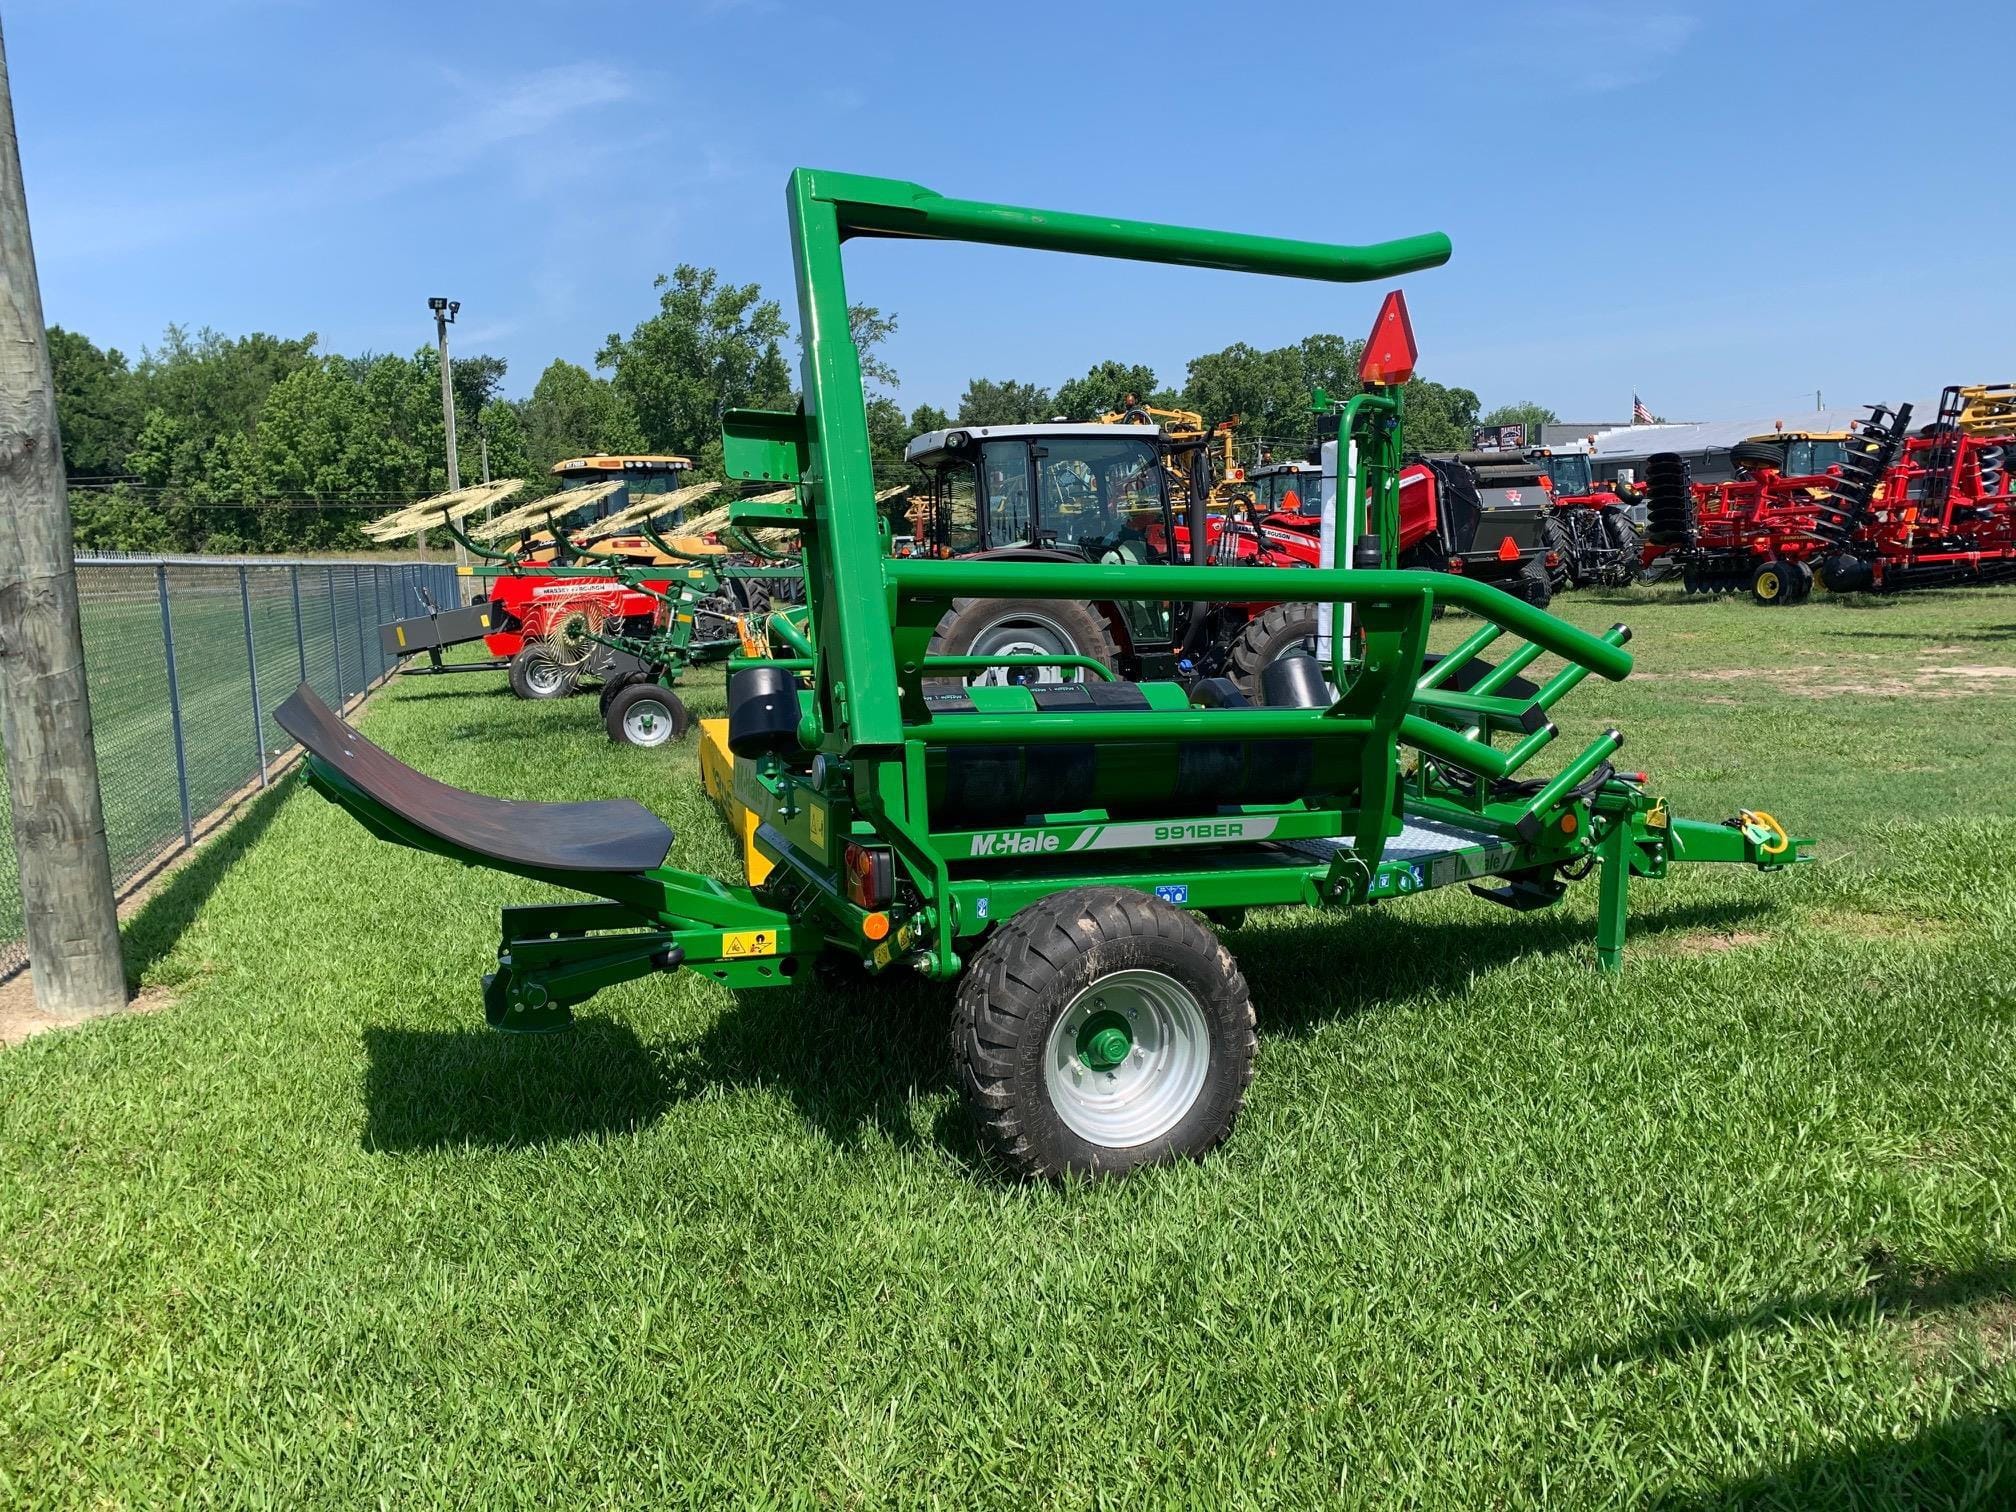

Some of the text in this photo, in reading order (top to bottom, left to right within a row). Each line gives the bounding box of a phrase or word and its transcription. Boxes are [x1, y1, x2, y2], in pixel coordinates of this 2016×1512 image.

[970, 823, 1243, 856] McHale 991BER
[1461, 852, 1501, 876] Male
